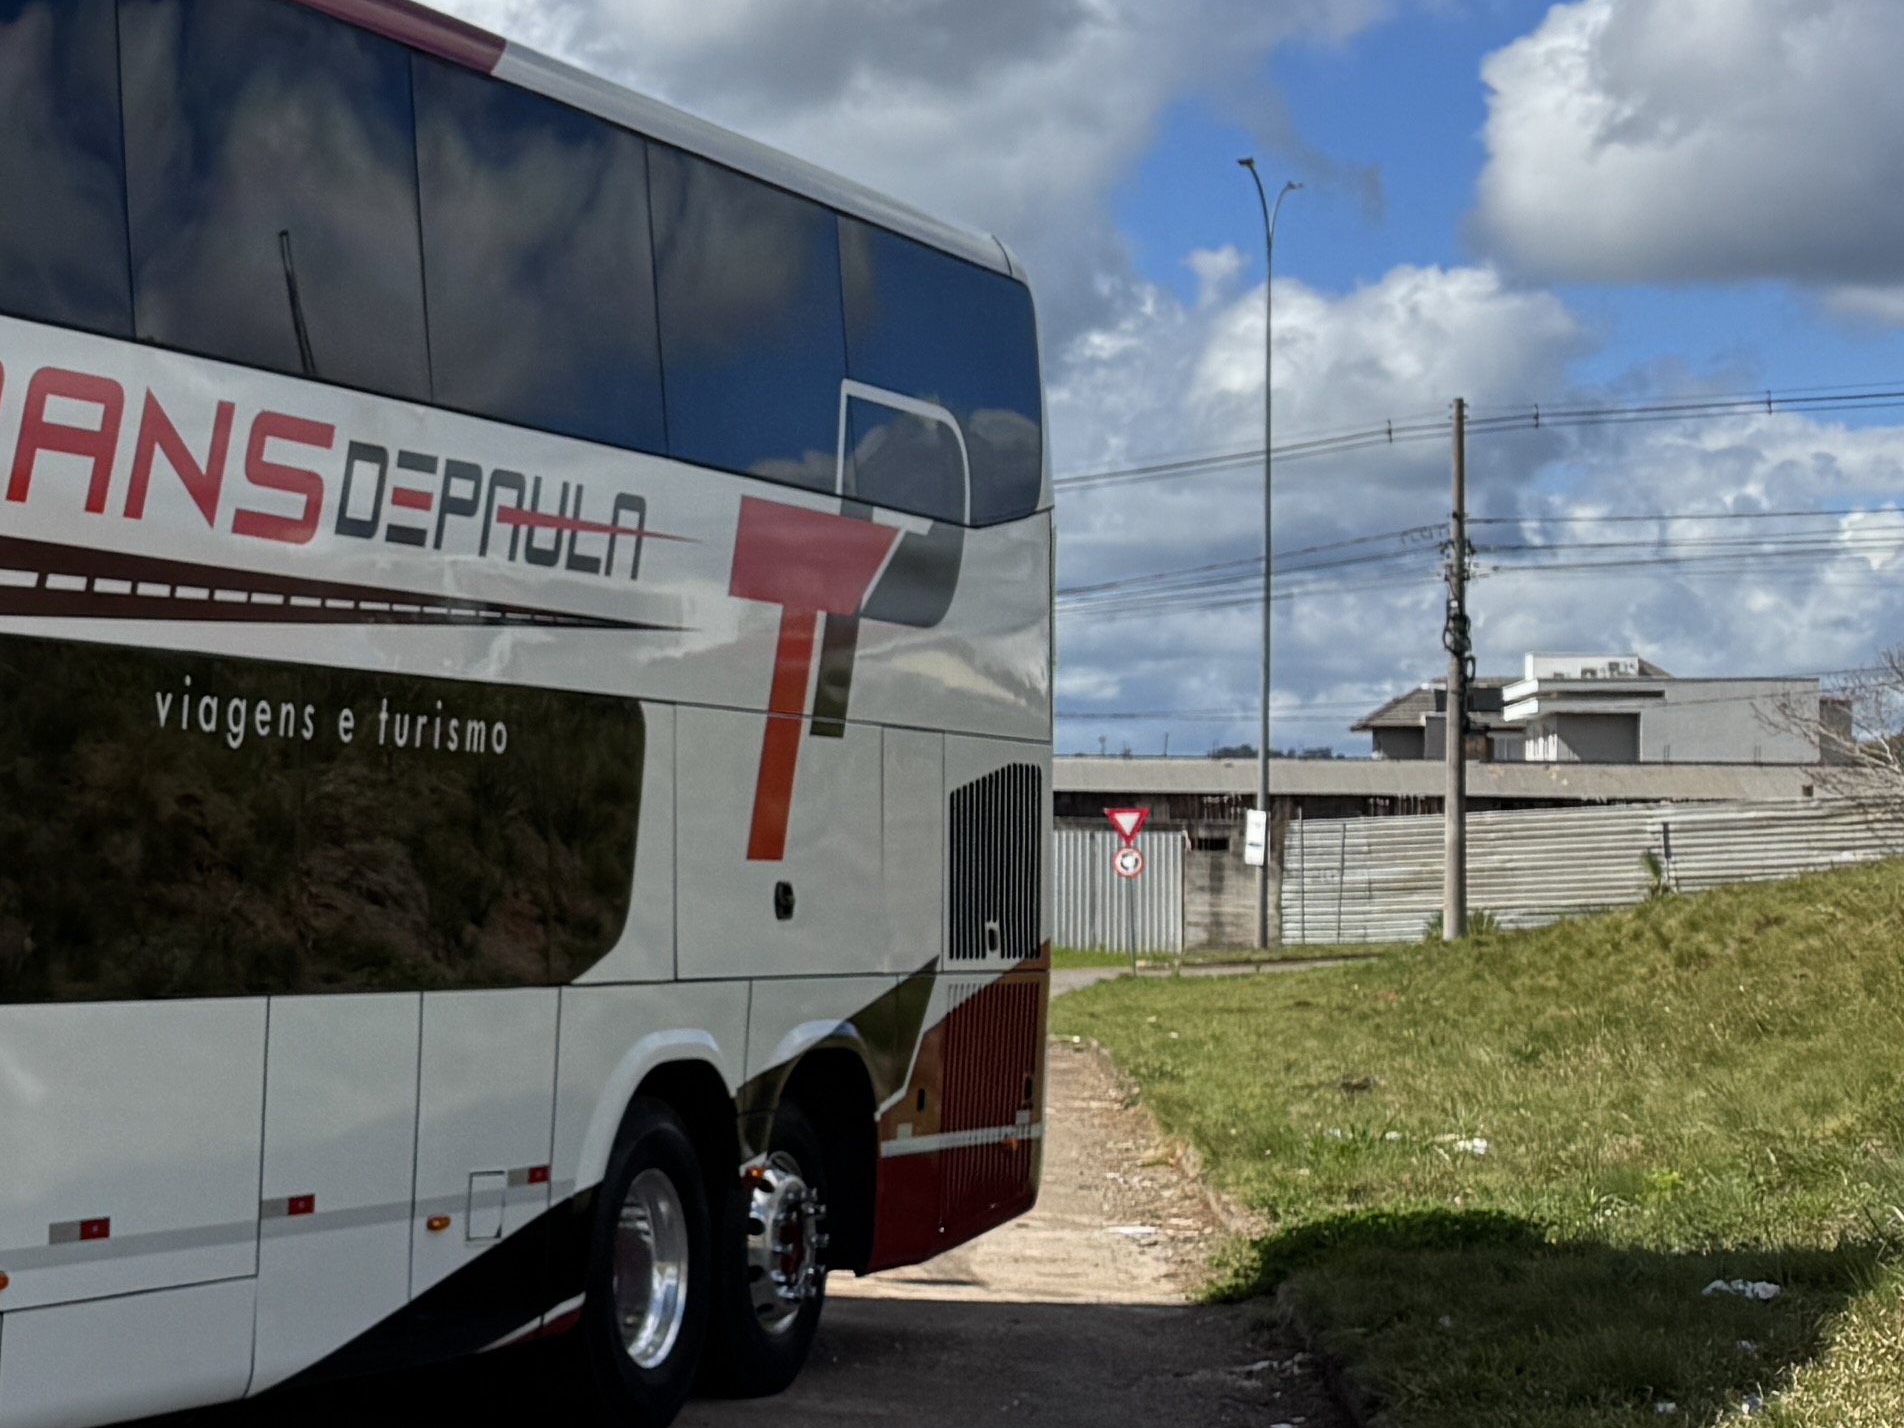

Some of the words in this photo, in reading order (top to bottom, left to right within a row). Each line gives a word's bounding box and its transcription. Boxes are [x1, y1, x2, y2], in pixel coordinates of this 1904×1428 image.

[155, 675, 316, 749] viagens
[337, 708, 355, 744] e
[378, 697, 509, 757] turismo
